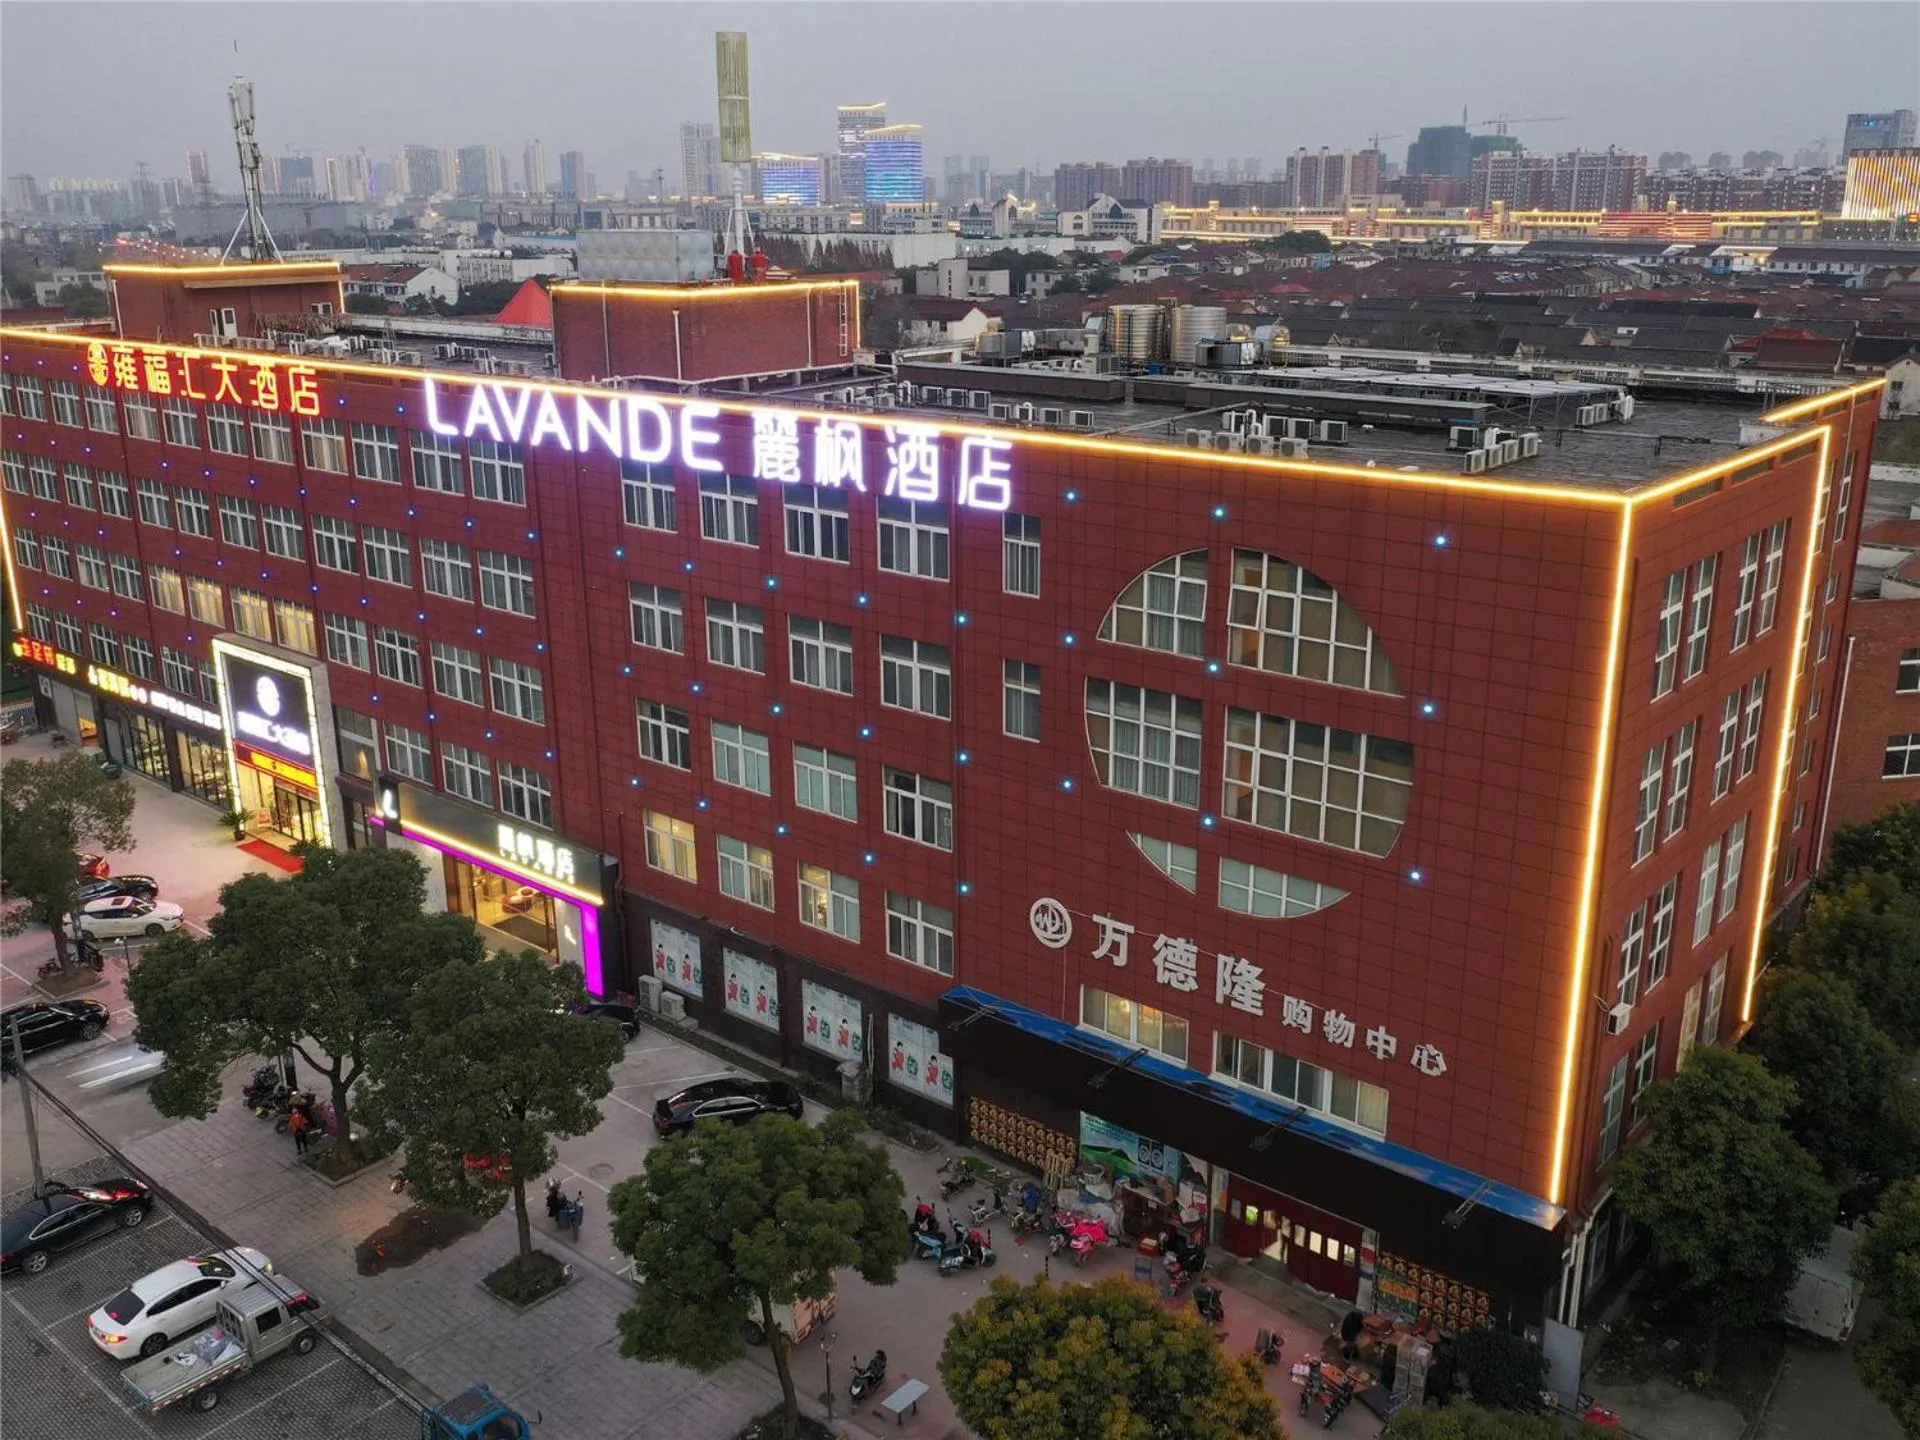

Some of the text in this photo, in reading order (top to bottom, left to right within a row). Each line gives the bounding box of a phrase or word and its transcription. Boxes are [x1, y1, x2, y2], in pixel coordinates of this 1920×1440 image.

[423, 377, 725, 472] LAVANDE
[1092, 912, 1449, 1077] 万德隆 购物中心
